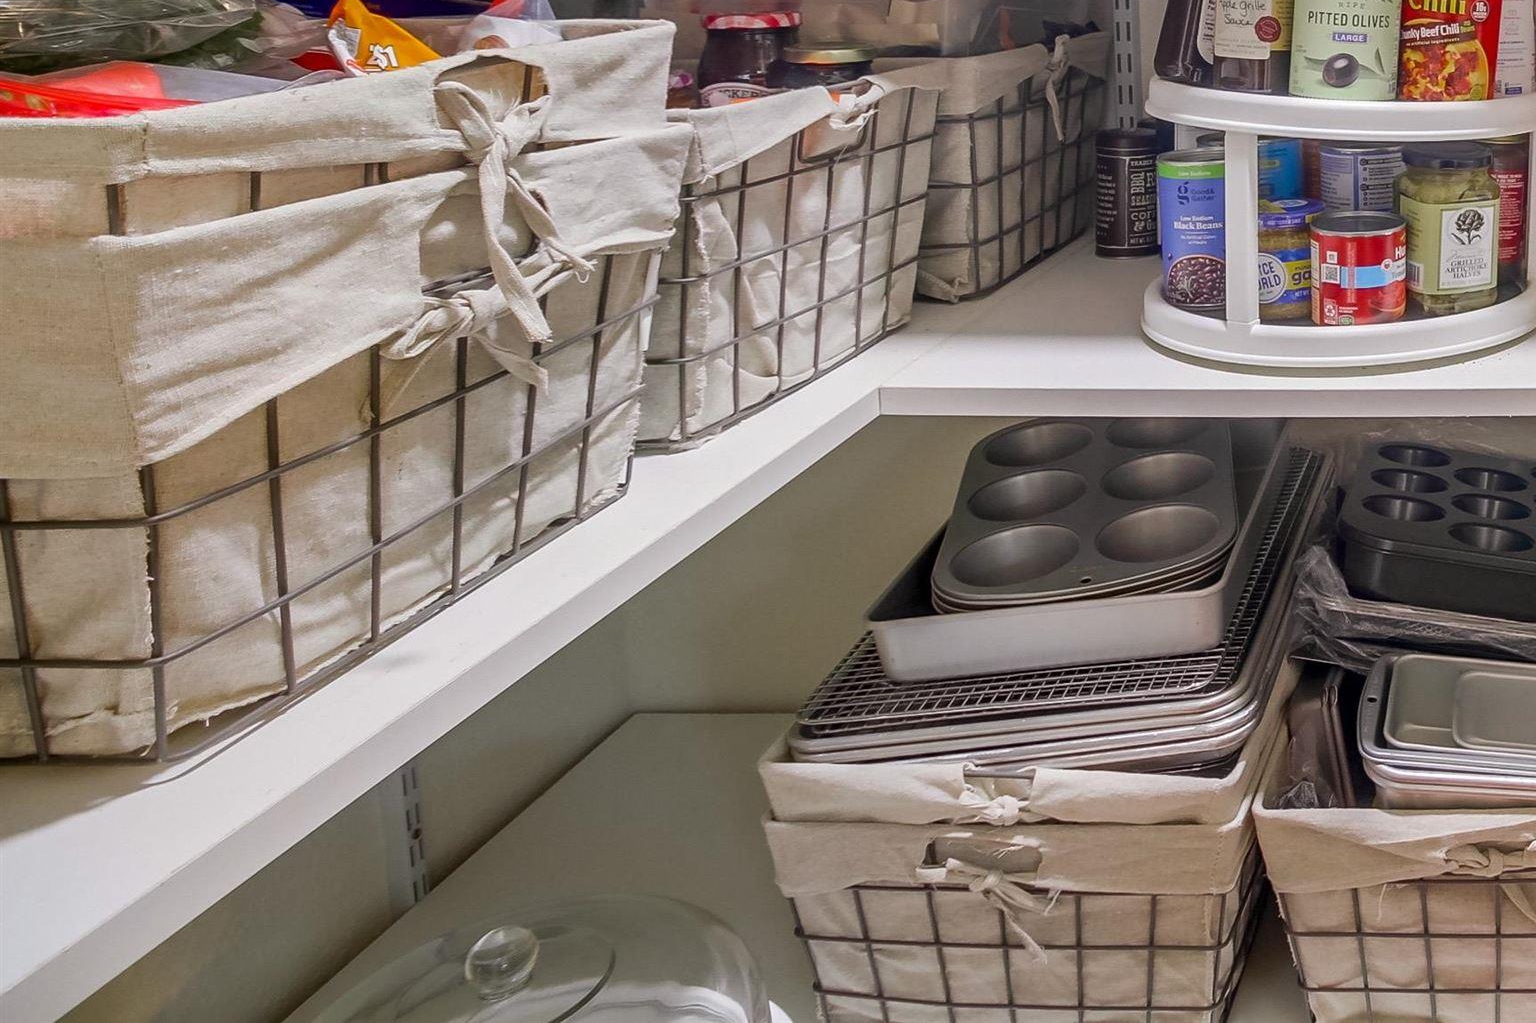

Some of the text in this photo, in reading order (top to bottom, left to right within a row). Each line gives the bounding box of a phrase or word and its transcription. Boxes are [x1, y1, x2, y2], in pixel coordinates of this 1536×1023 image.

[1308, 10, 1390, 28] PITTED OLIVES
[1420, 25, 1440, 38] Beef
[1440, 23, 1460, 36] Chili
[1335, 34, 1365, 42] LARGE
[1130, 172, 1145, 194] BBQ
[1173, 221, 1223, 230] Black Beans
[1450, 258, 1484, 267] GRILLED
[1445, 263, 1487, 273] ARTICHOKE
[1453, 271, 1481, 279] HALVES
